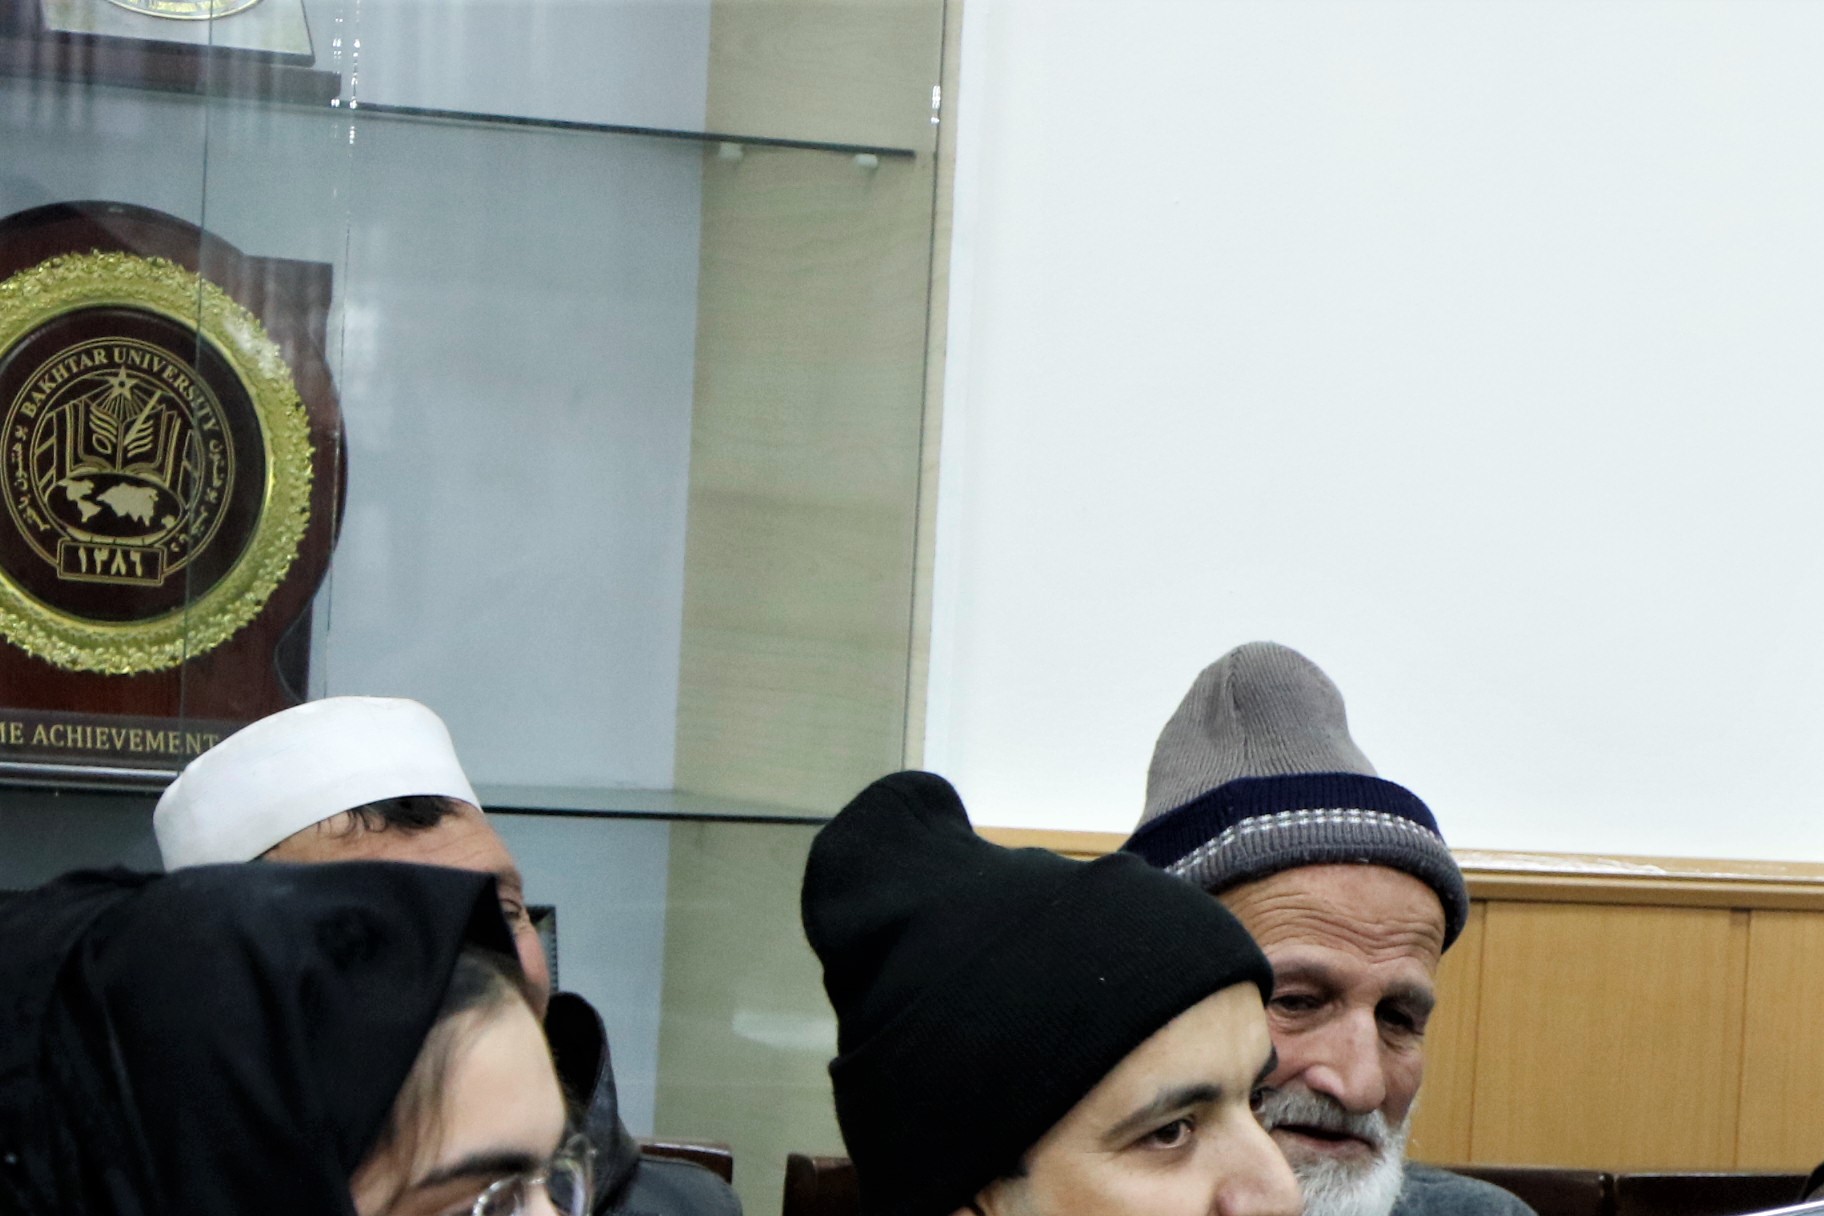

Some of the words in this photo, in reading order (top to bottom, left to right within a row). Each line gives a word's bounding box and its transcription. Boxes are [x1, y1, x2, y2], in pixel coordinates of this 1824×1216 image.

[20, 348, 109, 418] BAKHTAR
[113, 347, 219, 431] UNIVERSITY
[31, 724, 219, 754] ACHIEVEMENT
